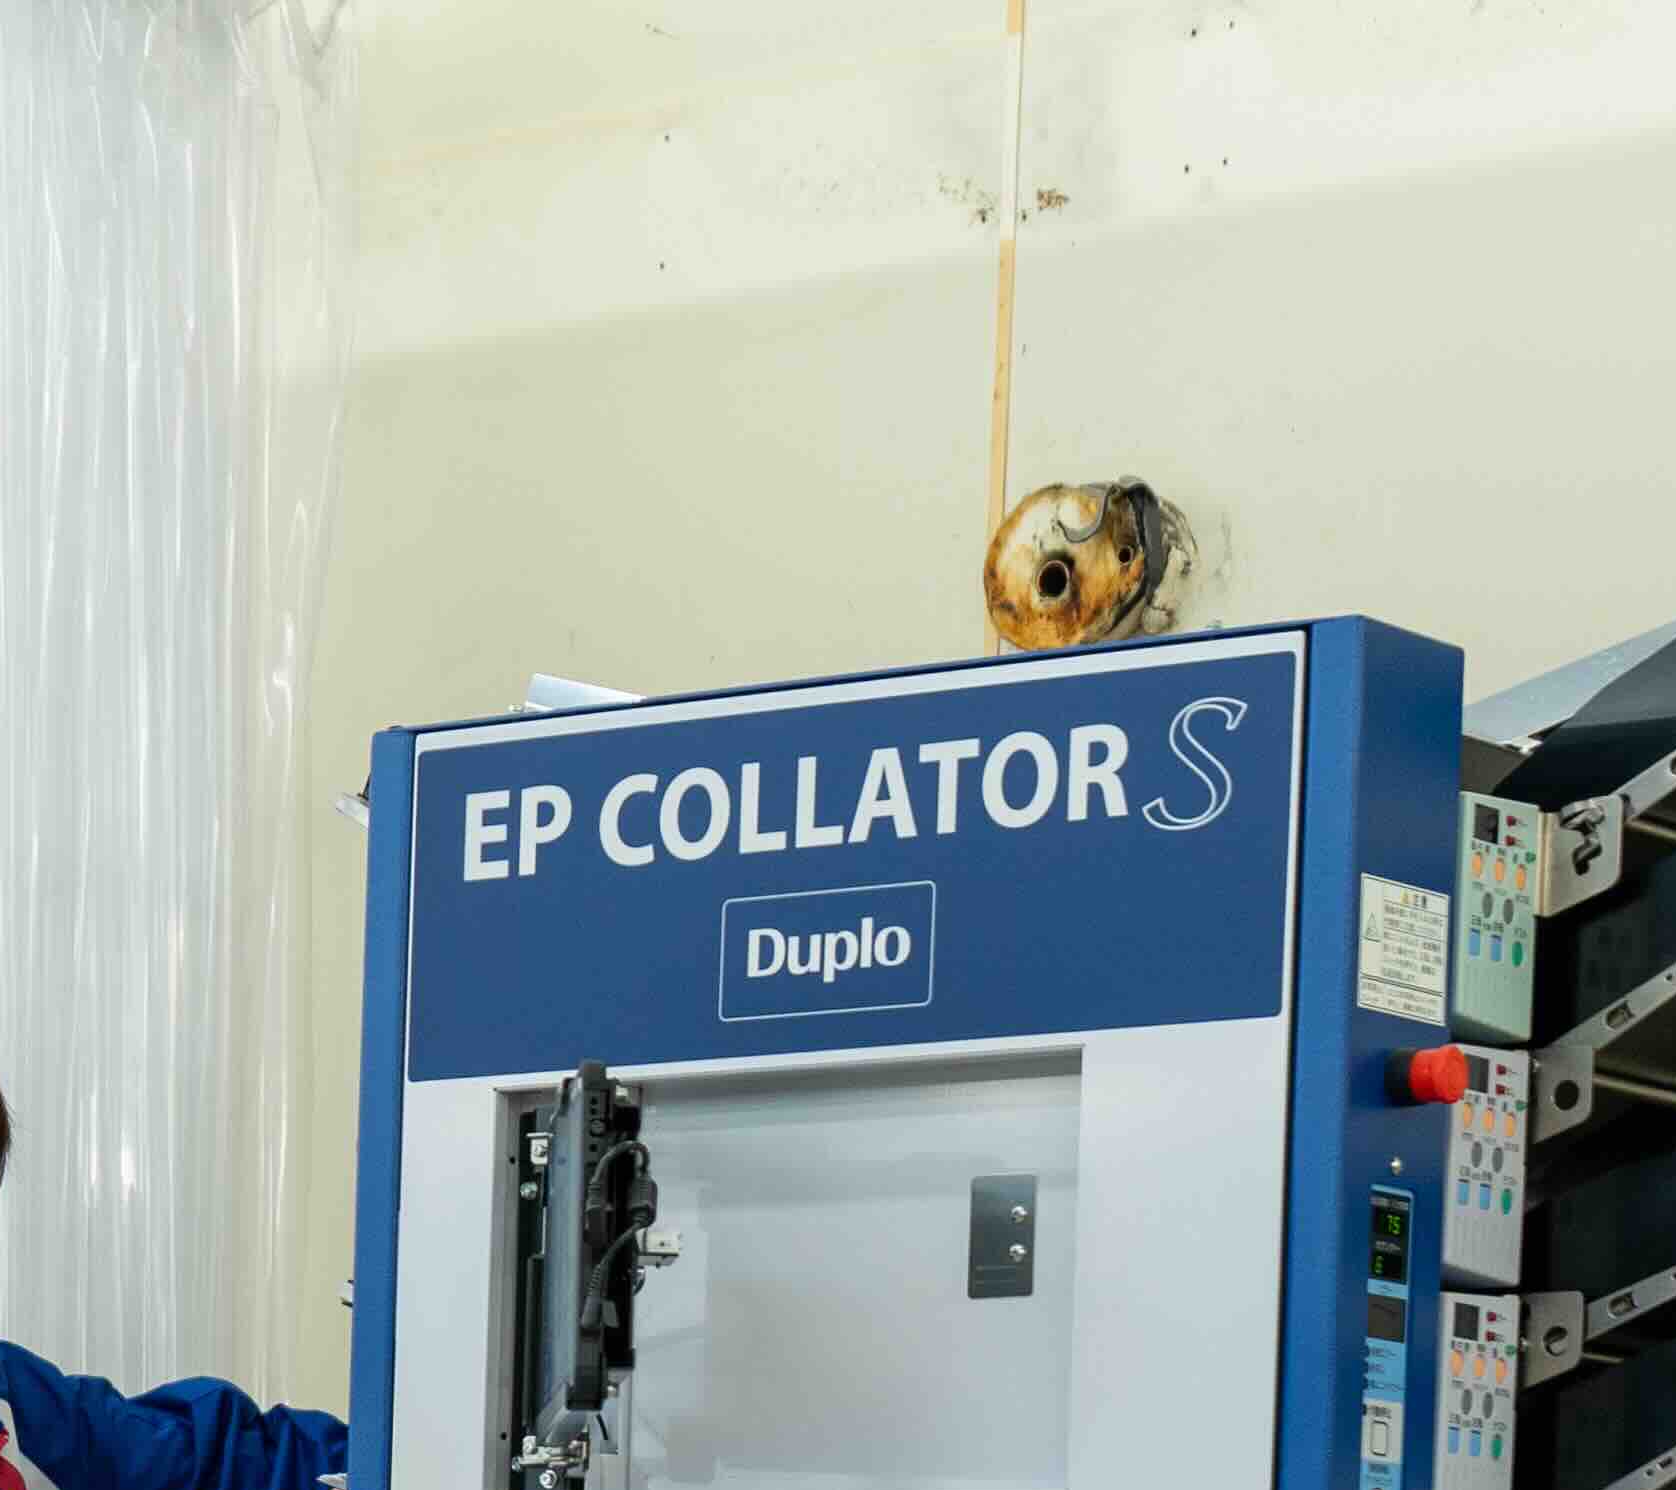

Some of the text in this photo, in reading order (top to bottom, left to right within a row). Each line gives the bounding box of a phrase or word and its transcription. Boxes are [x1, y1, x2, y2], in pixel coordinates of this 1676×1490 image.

[463, 696, 1248, 882] EP COLLATOR S
[746, 916, 912, 984] Duplo
